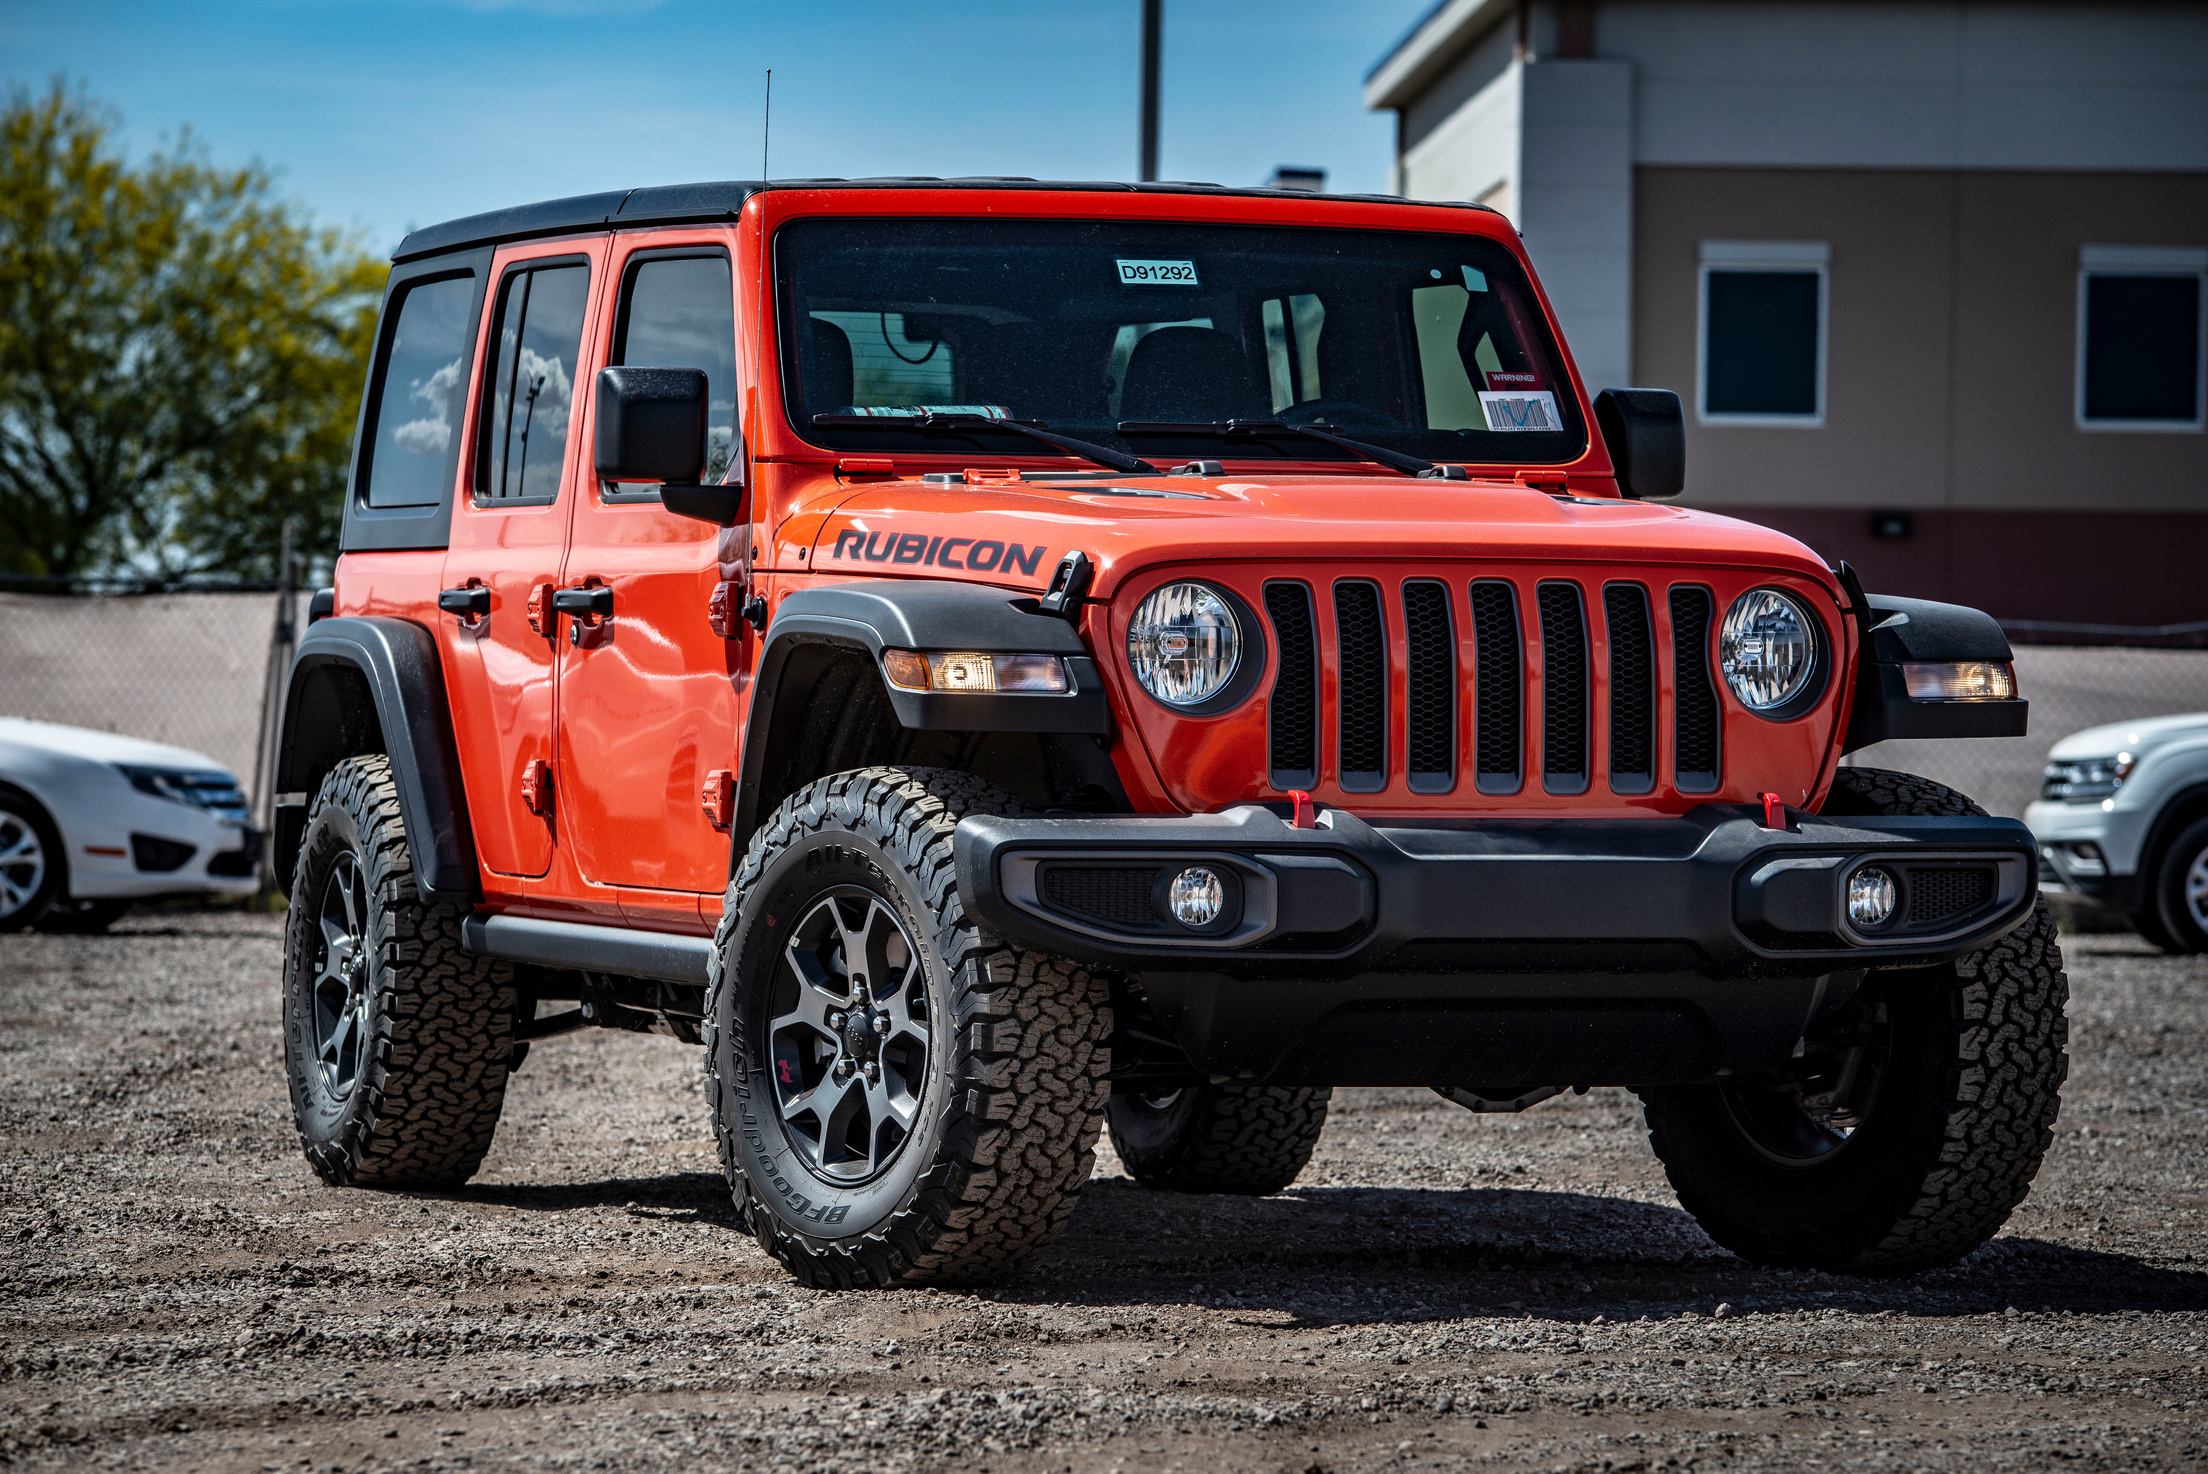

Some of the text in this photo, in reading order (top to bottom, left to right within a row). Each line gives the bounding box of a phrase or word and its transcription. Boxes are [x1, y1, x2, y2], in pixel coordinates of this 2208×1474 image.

[1122, 265, 1195, 280] D91292
[1492, 373, 1536, 382] WARNING!
[831, 529, 1048, 577] RUBICON
[805, 842, 935, 986] All-Terrain
[291, 905, 314, 1110] All-Terrain
[727, 1017, 851, 1225] BFGoodrich
